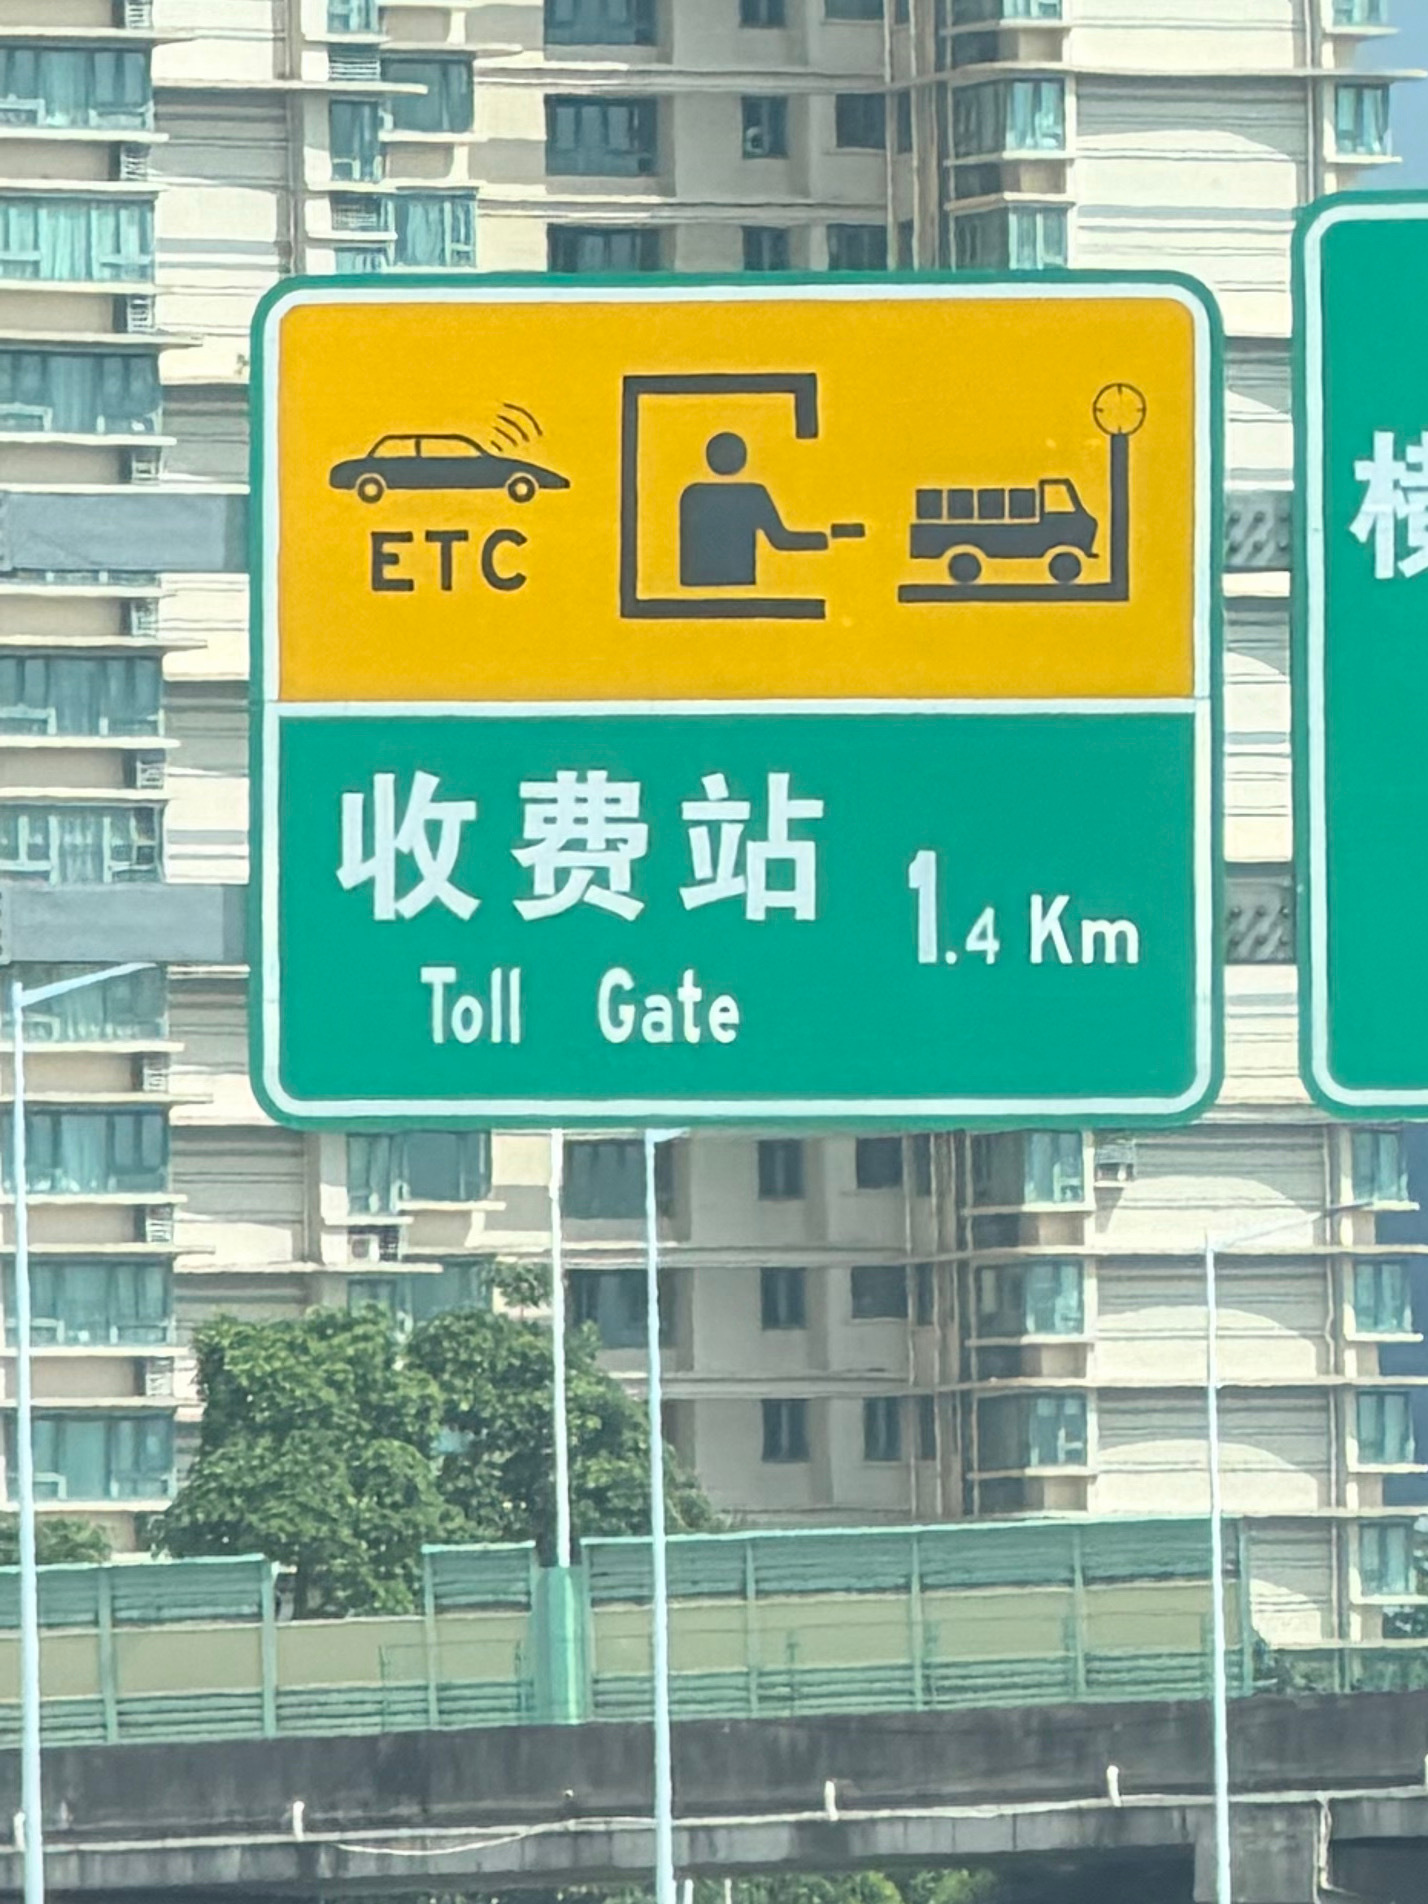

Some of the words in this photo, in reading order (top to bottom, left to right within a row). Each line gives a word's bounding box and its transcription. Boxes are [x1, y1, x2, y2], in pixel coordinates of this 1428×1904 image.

[371, 529, 528, 592] ETC
[336, 769, 824, 921] 收费站
[908, 850, 1000, 964] 1.4
[1030, 894, 1139, 964] Km
[420, 966, 521, 1044] Toll
[598, 967, 740, 1044] Gate
